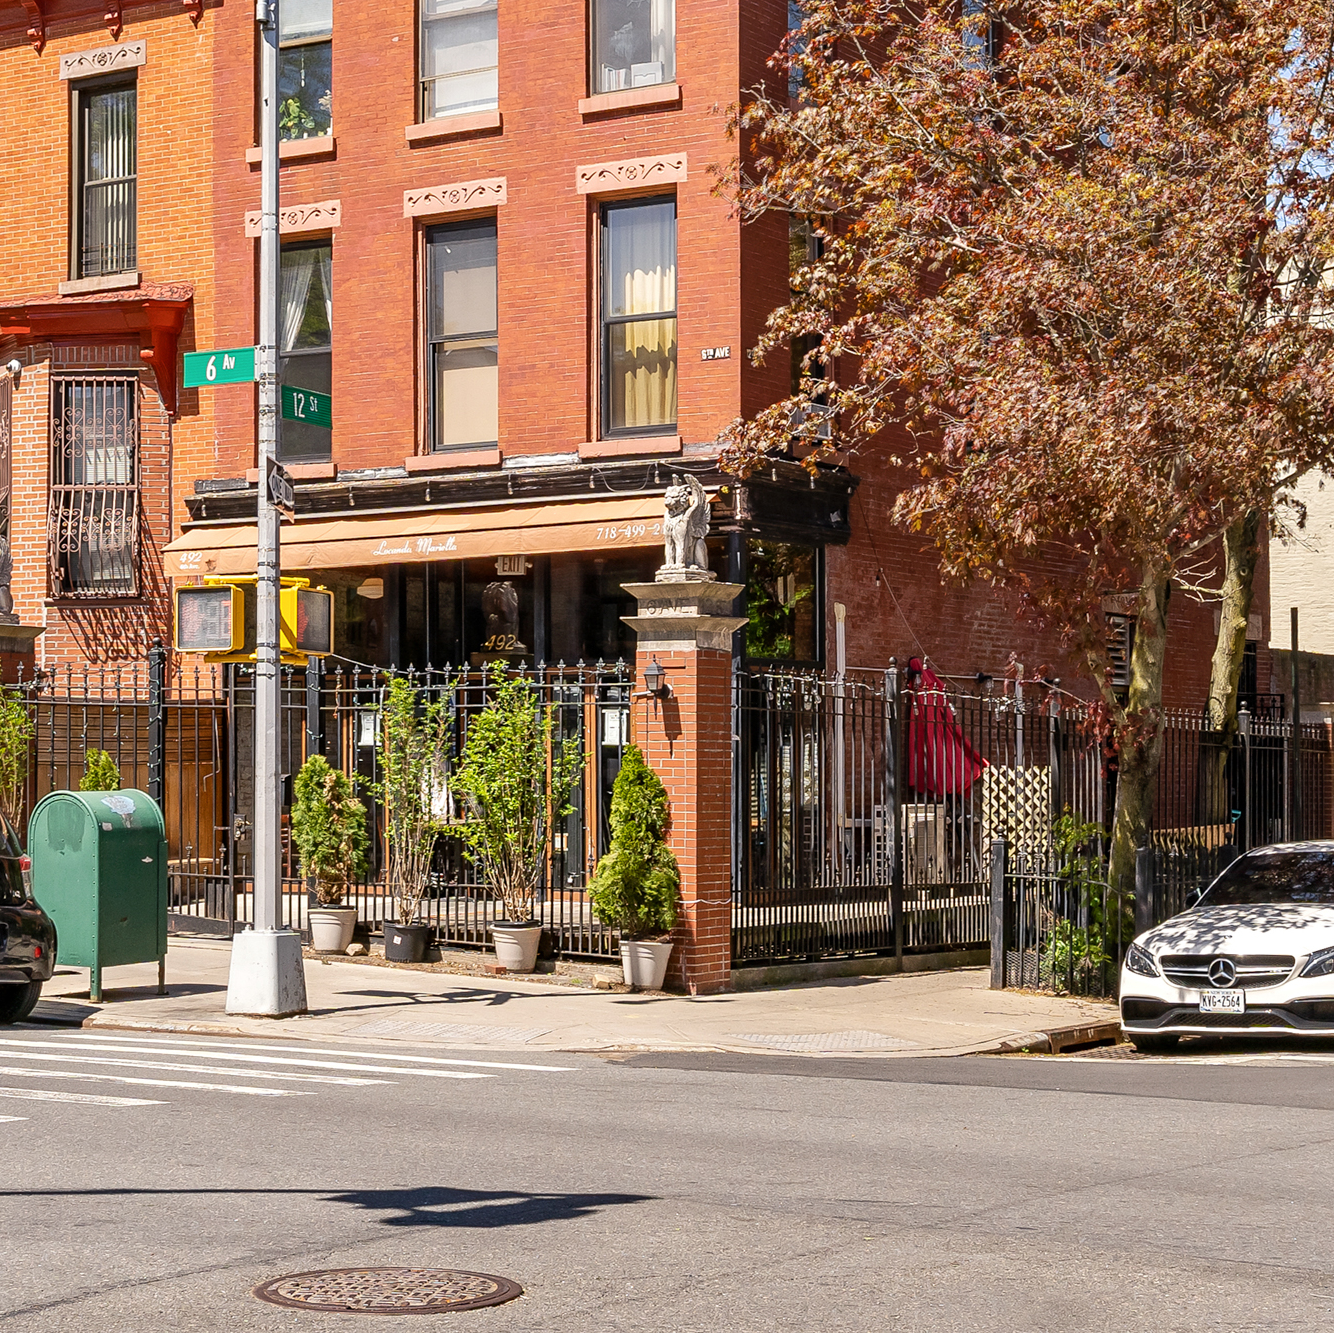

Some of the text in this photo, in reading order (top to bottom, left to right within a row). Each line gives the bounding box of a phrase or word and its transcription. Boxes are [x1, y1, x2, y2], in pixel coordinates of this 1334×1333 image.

[714, 346, 730, 358] AVE
[206, 354, 236, 381] 6 Av
[293, 392, 318, 418] 12 St
[372, 540, 412, 556] Locanda
[179, 552, 203, 563] 492
[485, 634, 517, 651] 492
[1221, 995, 1240, 1007] 2564
